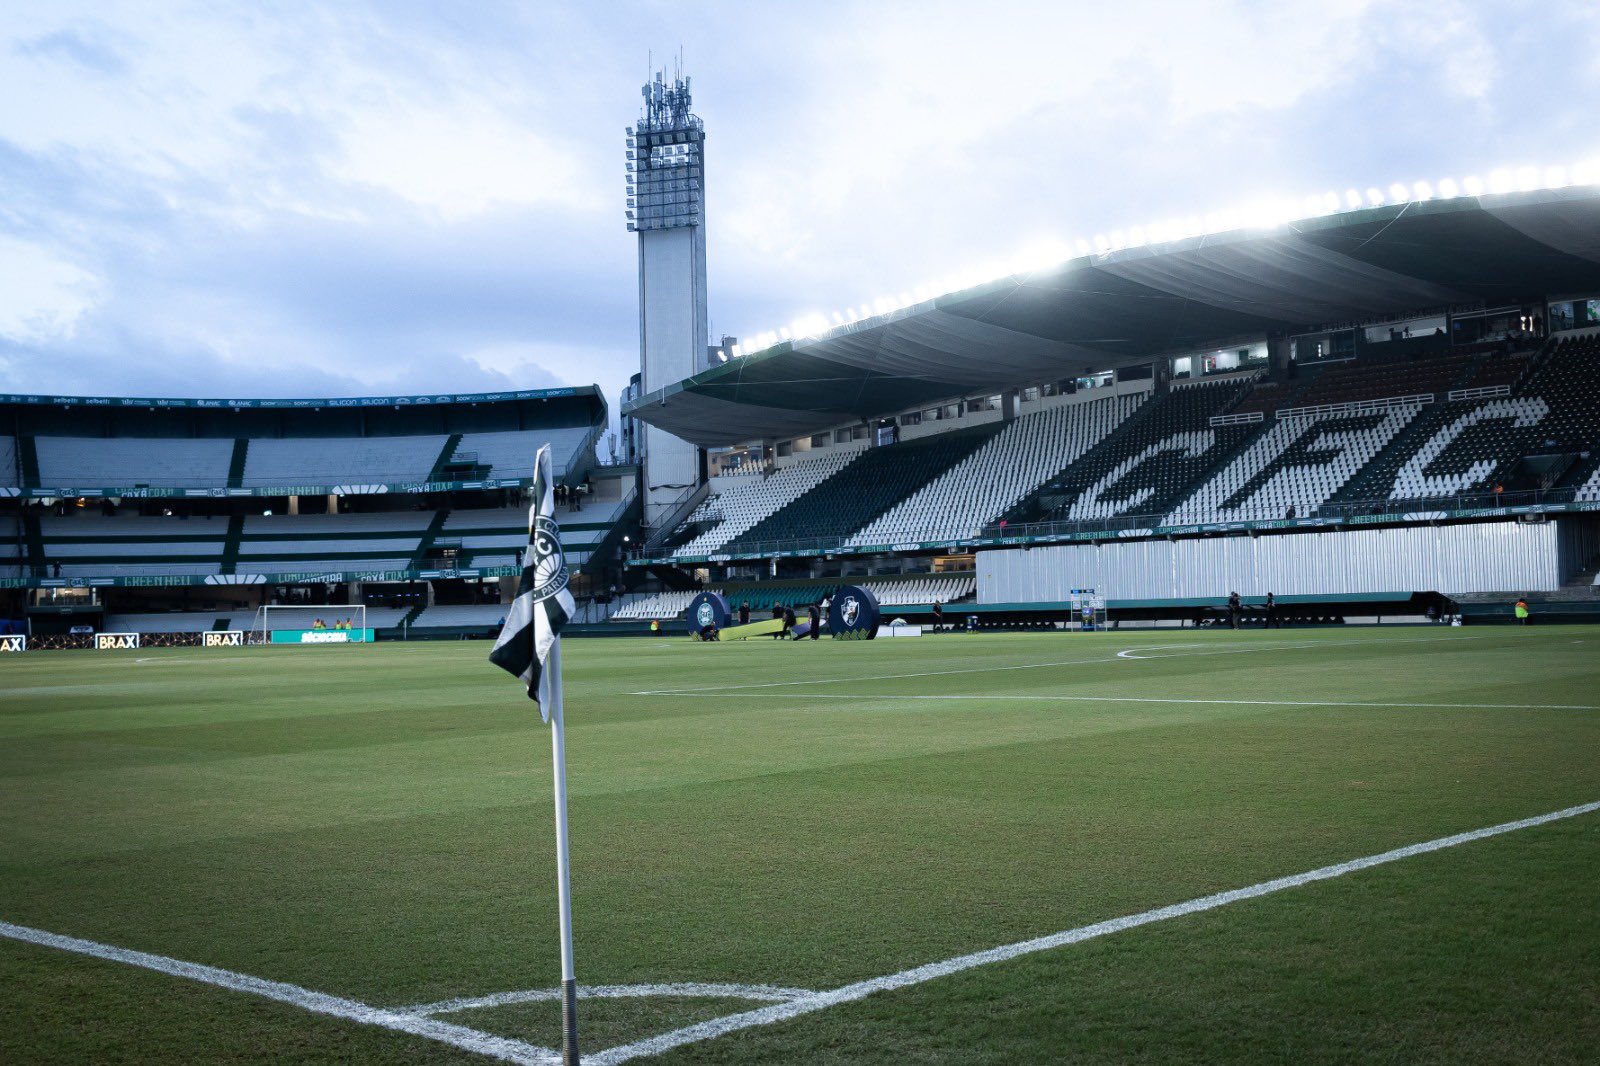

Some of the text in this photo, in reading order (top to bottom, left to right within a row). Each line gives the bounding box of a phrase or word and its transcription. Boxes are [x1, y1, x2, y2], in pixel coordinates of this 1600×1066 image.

[124, 576, 163, 587] GREEN
[99, 635, 136, 649] BRAX
[206, 633, 240, 646] BRAX
